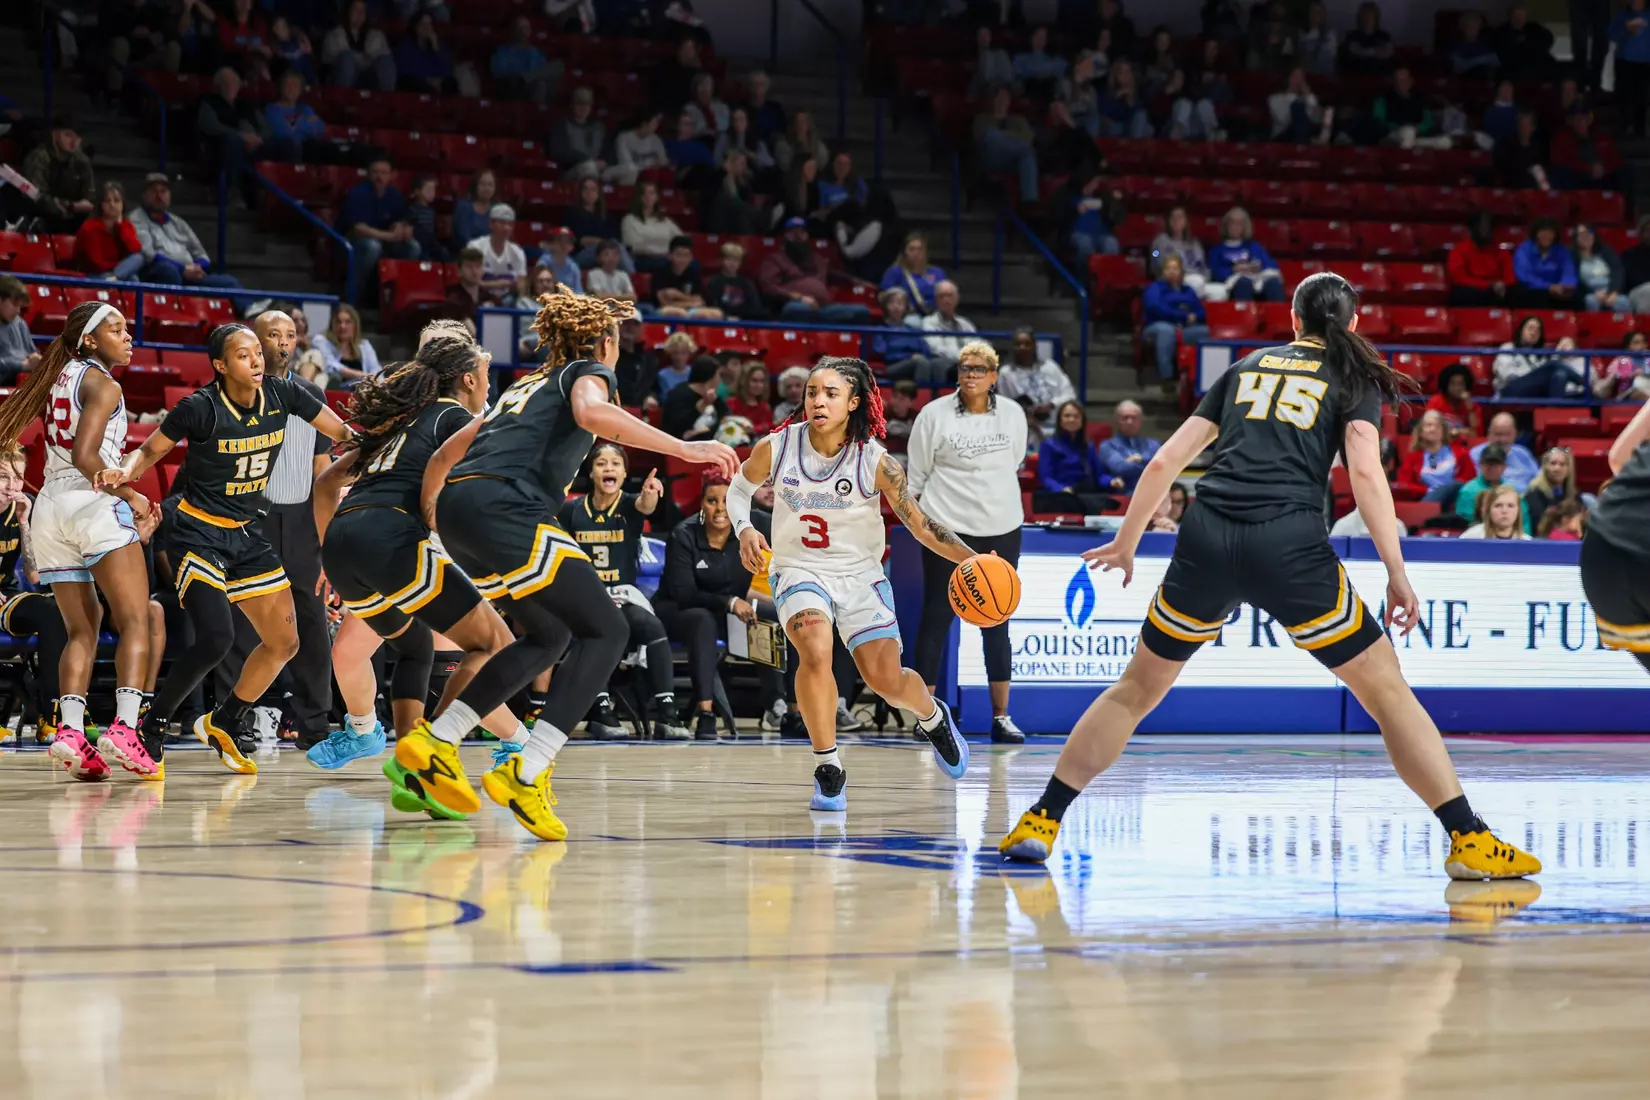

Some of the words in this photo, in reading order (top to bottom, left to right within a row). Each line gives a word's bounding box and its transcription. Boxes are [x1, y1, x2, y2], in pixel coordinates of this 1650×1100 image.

[1235, 372, 1329, 430] 45
[217, 428, 285, 454] KENNESAW
[234, 451, 271, 479] 15
[225, 476, 269, 496] STATE
[800, 514, 830, 549] 3
[592, 545, 610, 568] 3
[596, 568, 621, 582] ATE
[961, 560, 986, 607] Wilson
[1524, 601, 1607, 651] FU
[1011, 625, 1141, 656] ouisiana
[1011, 661, 1071, 676] ROPANE
[1075, 661, 1130, 676] DEALE
